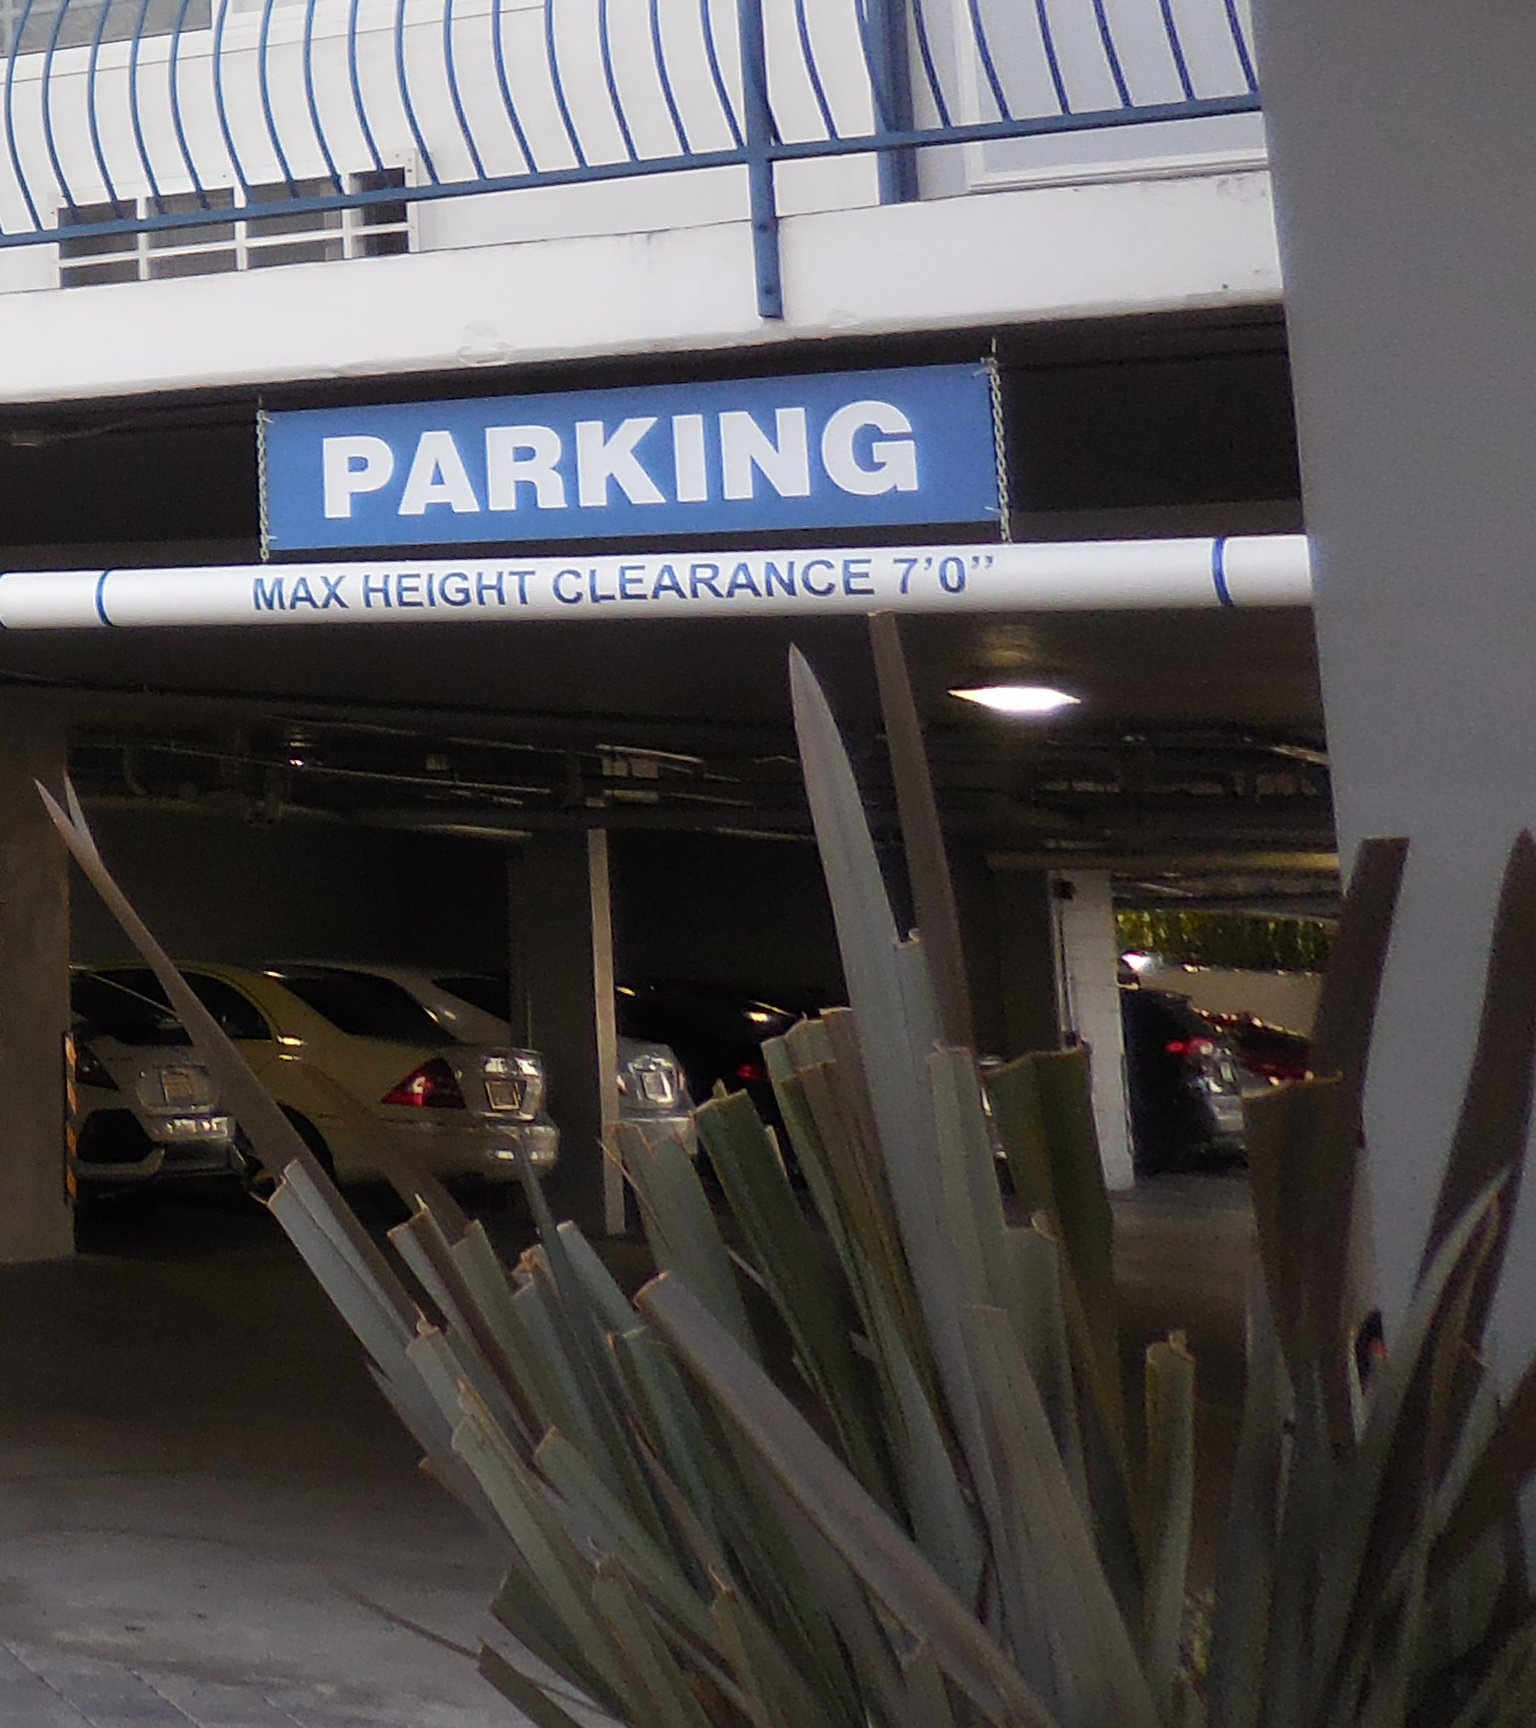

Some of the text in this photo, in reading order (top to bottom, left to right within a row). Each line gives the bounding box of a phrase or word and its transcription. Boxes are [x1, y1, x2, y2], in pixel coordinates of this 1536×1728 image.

[322, 400, 919, 519] PARKING
[252, 575, 350, 611] MAX
[362, 570, 536, 609] HEIGHT
[552, 558, 875, 605] CLEARANCE
